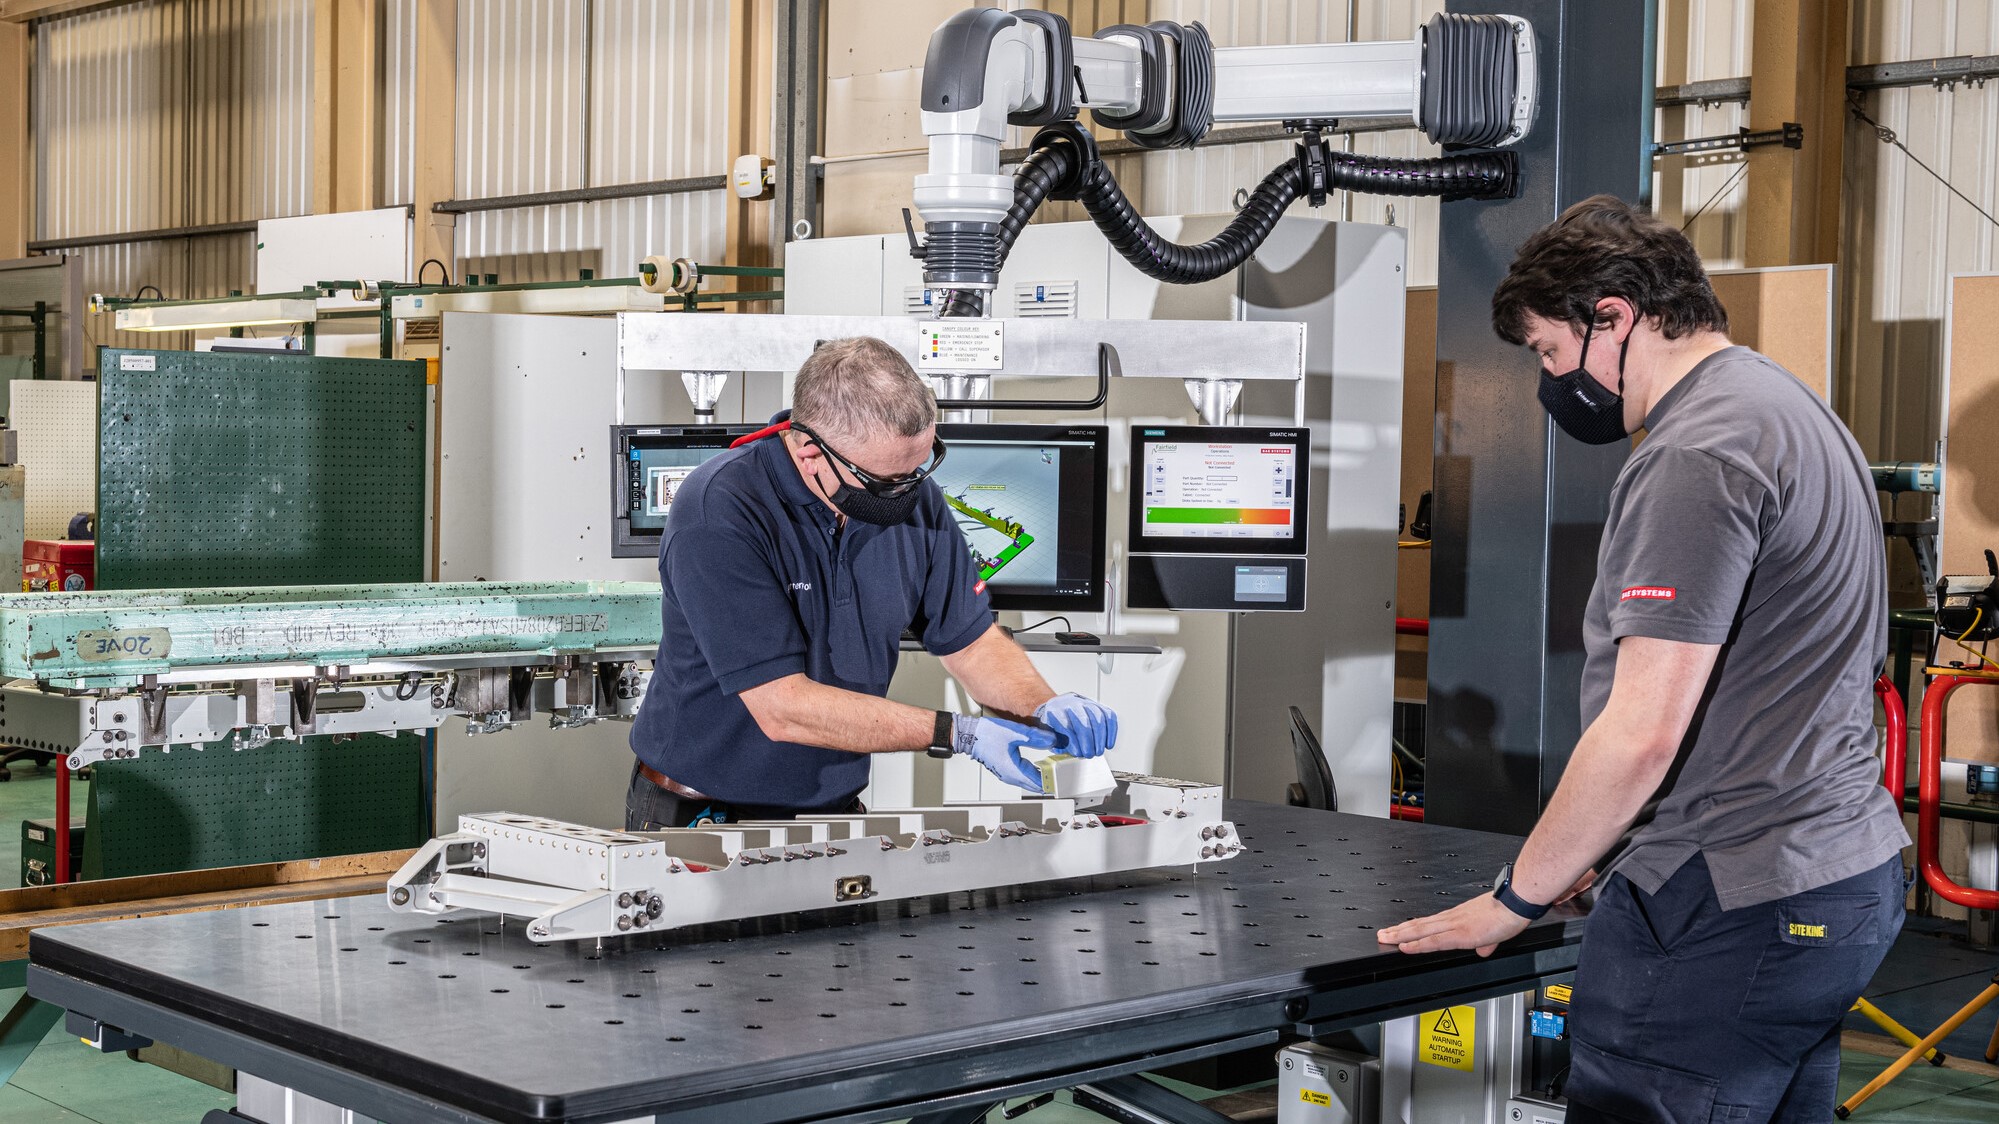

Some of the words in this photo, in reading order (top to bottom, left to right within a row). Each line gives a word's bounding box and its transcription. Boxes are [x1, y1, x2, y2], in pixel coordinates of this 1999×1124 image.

[1631, 589, 1672, 598] SYSTEMS
[1432, 1035, 1462, 1047] WARNING
[1429, 1043, 1465, 1057] AUTOMATIC
[1432, 1053, 1461, 1065] STARTUP
[1311, 1092, 1329, 1101] DANGER
